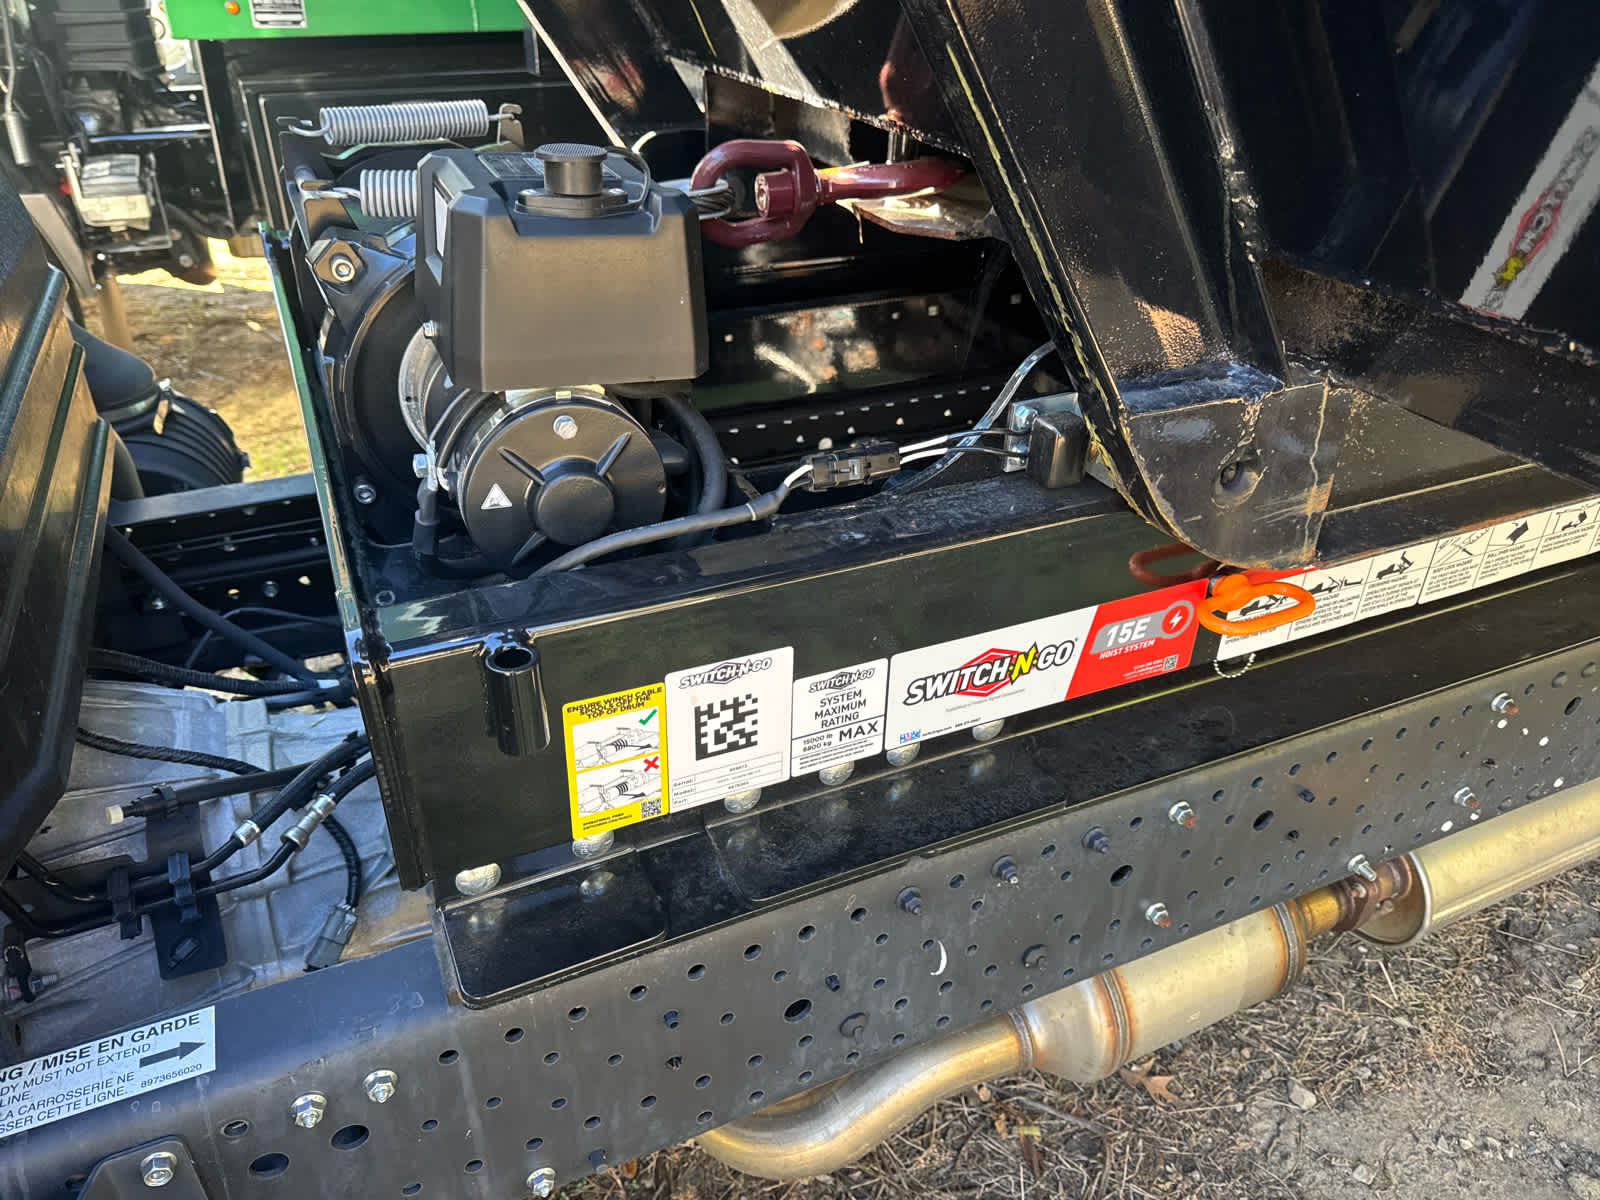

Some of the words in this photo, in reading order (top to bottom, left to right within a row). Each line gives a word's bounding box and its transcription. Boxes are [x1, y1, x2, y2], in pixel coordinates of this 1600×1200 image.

[1106, 616, 1152, 647] 15E
[1099, 648, 1123, 660] HOIST
[1123, 639, 1156, 653] SYSTEM
[567, 700, 601, 713] ENSURE
[603, 692, 633, 705] WINCH
[635, 687, 663, 698] CABLE
[635, 695, 651, 704] THE
[814, 698, 867, 720] MAXIMUM
[820, 689, 862, 708] SYSTEM
[587, 710, 604, 719] TOP
[607, 707, 618, 715] OF
[620, 702, 645, 712] DRUM
[821, 711, 860, 729] RATING
[839, 720, 879, 742] MAX
[41, 1045, 92, 1071] MISE
[98, 1036, 124, 1054] EN
[131, 1013, 200, 1043] GARDE
[23, 1070, 62, 1090] MUST
[65, 1061, 93, 1077] NOT
[97, 1043, 151, 1066] EXTEND
[17, 1078, 113, 1116] CARROSSERIE
[117, 1071, 135, 1085] NE
[37, 1099, 82, 1122] CETTE
